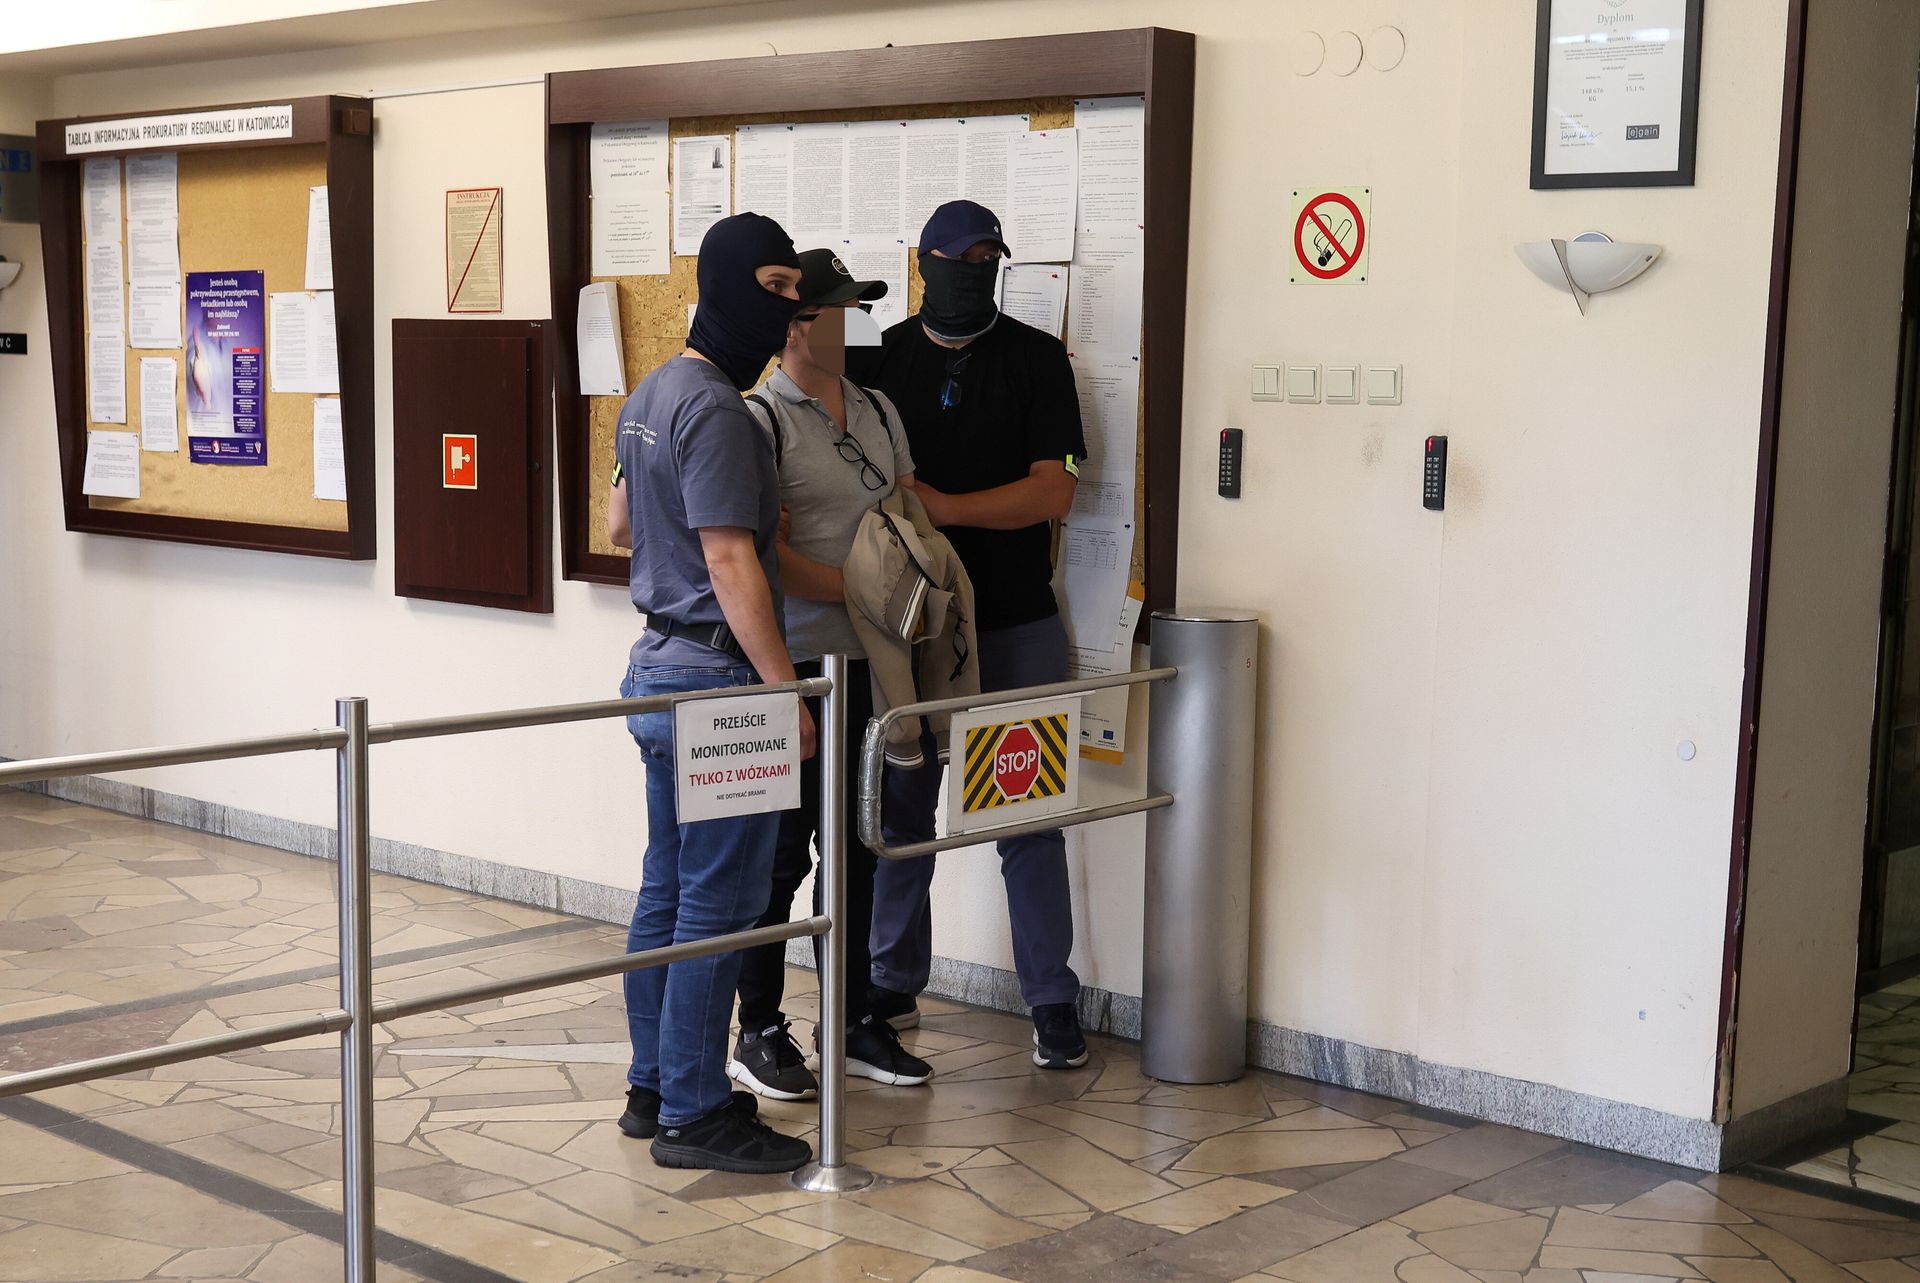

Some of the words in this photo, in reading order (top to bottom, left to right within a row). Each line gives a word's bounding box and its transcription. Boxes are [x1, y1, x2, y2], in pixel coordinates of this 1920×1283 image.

[1597, 13, 1634, 26] Dyplom
[68, 131, 91, 146] TABLICA
[95, 127, 140, 143] INFORMACYJNA
[143, 122, 188, 139] PROKURATURY
[191, 119, 235, 135] REGIONALNEJ
[238, 118, 244, 132] W
[246, 115, 289, 131] KATOWICACH
[457, 191, 490, 200] INSTRUKCJA
[210, 278, 223, 288] Jesteś
[224, 278, 238, 288] osobą
[190, 289, 222, 299] pokrzywdzoną
[223, 289, 259, 298] przestępstwem,
[200, 299, 225, 308] świadkiem
[234, 298, 248, 308] osobą
[207, 310, 214, 318] im
[215, 309, 240, 319] najbliższą?
[713, 712, 767, 731] PRZEJŚCIE
[691, 738, 787, 760] MONITOROWANE
[997, 749, 1037, 775] STOP
[689, 771, 723, 787] TYLKO
[726, 770, 733, 782] Z
[736, 763, 791, 781] WÓZKAMI
[726, 791, 747, 800] DOTYKAĆ
